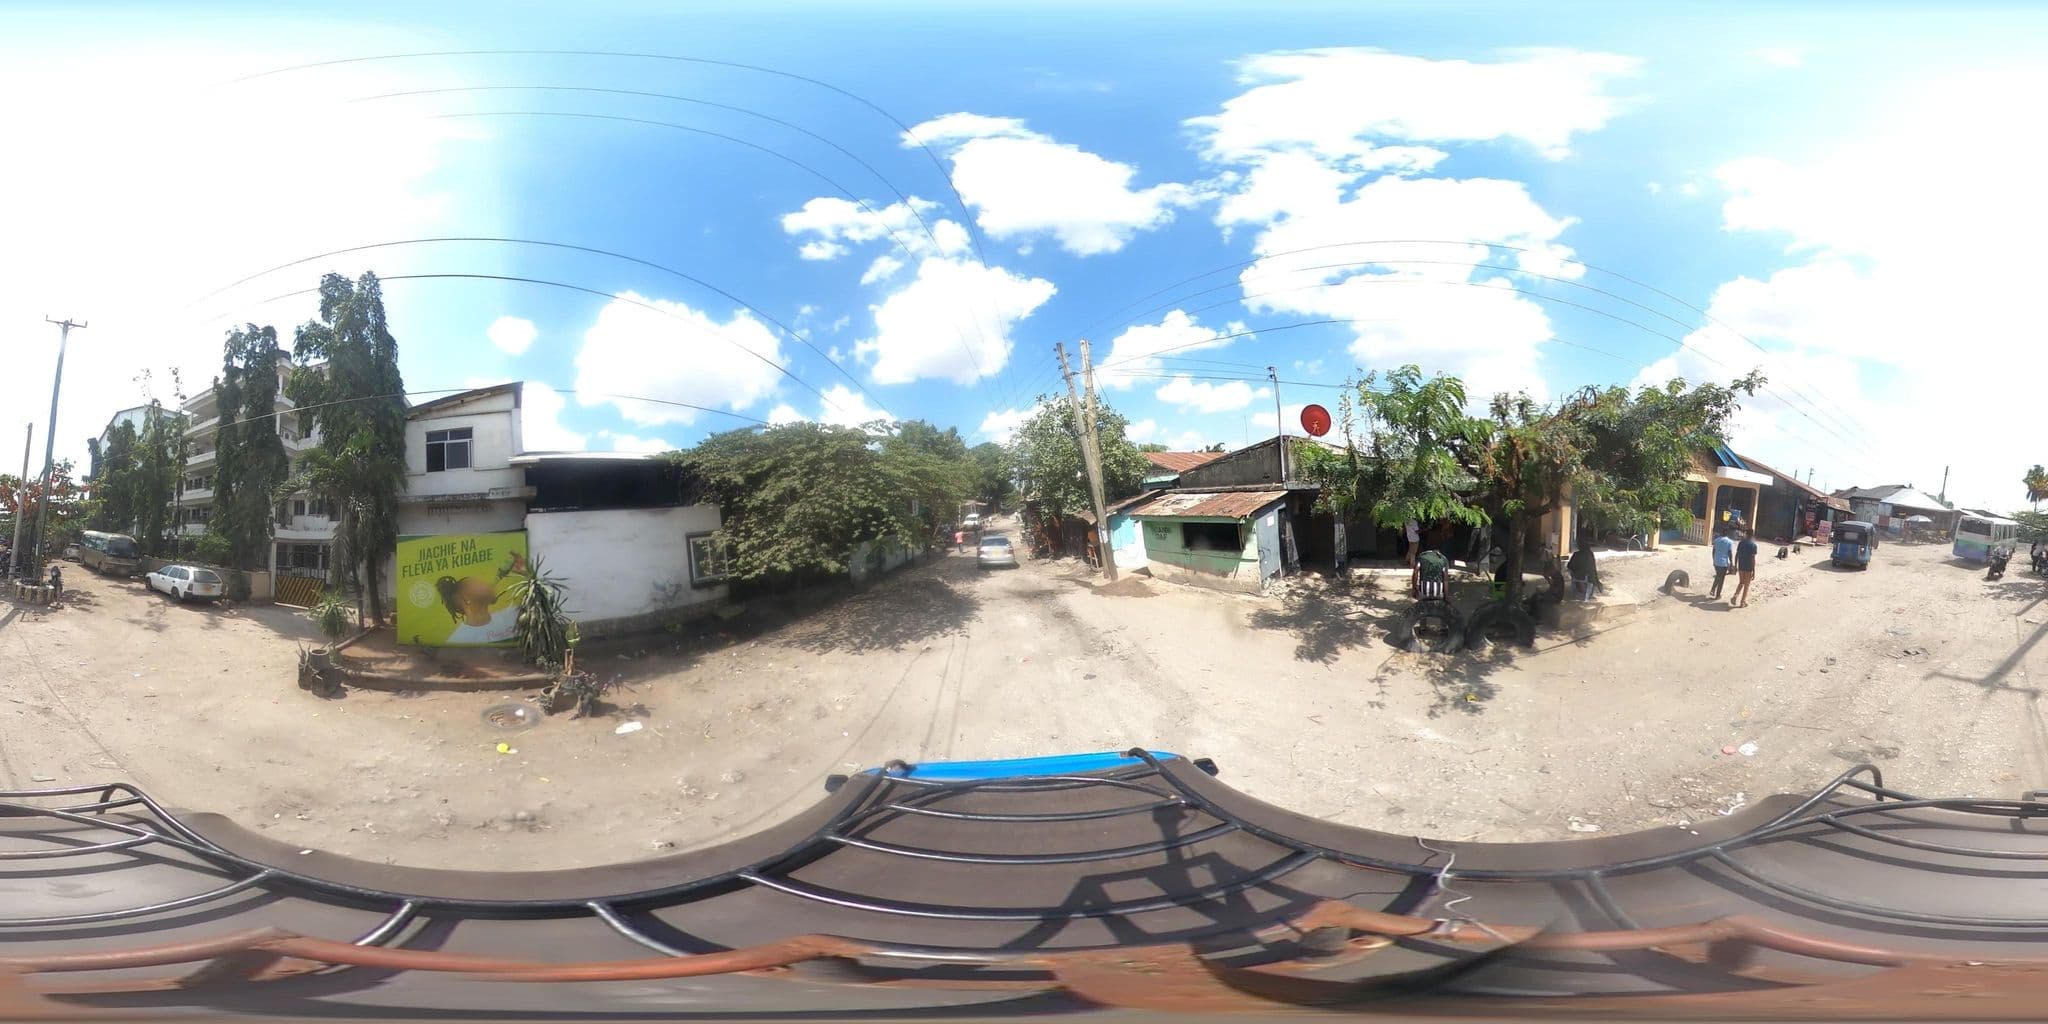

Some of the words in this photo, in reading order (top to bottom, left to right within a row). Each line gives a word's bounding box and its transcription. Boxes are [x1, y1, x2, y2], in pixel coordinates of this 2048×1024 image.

[418, 542, 457, 561] JIACHIE
[461, 538, 477, 552] NA
[402, 561, 434, 578] FLEVA
[436, 558, 448, 571] YA
[452, 548, 494, 568] KIBABE
